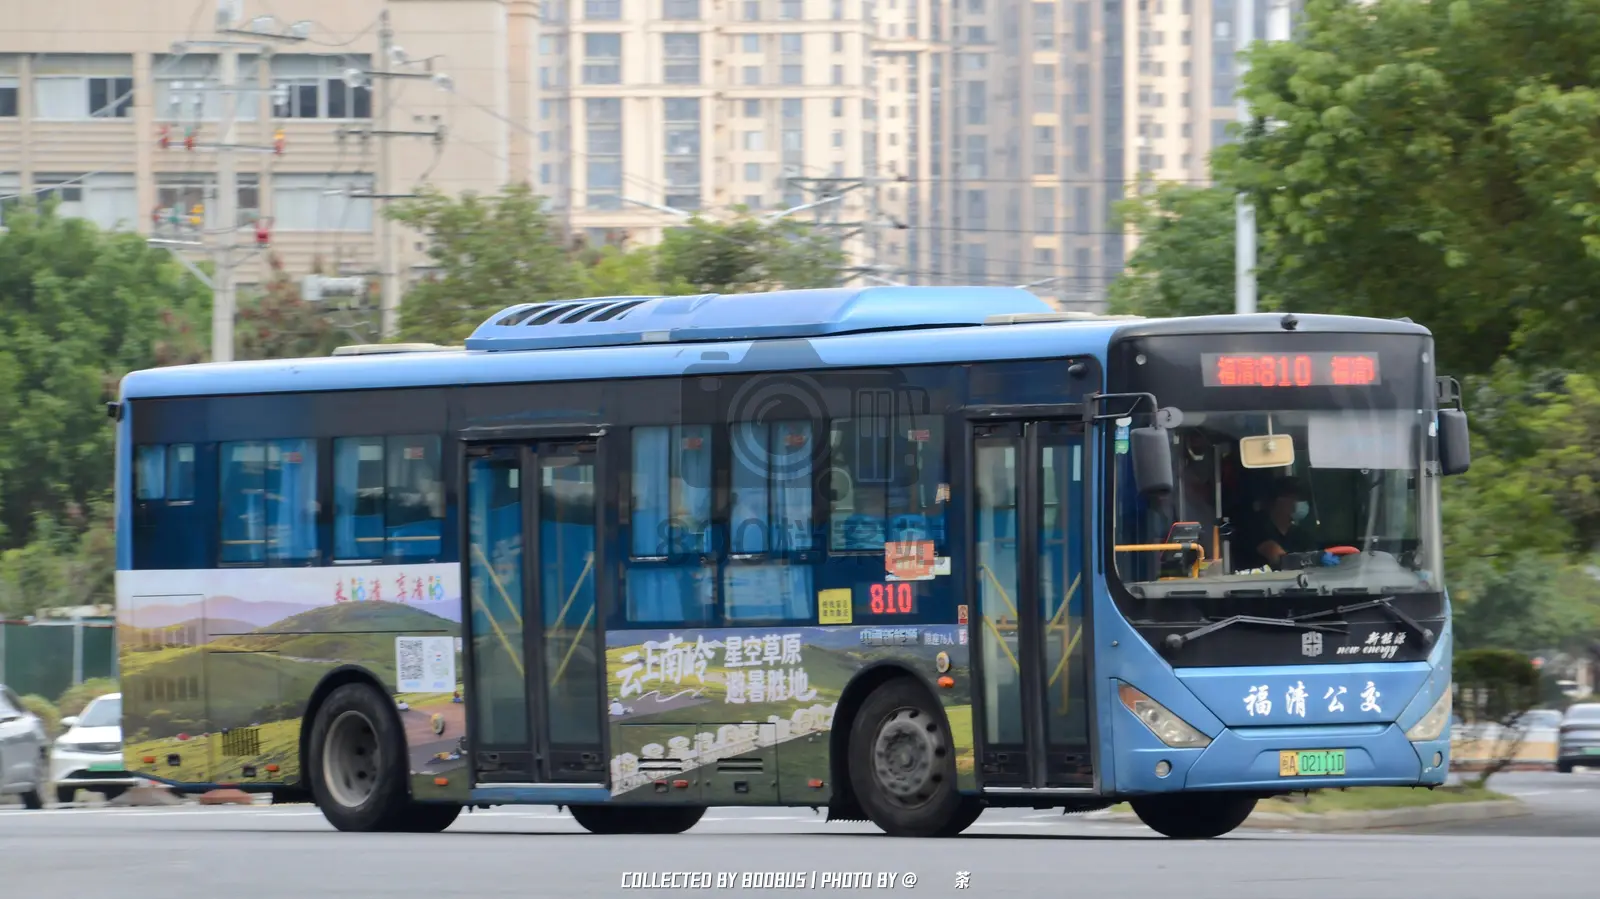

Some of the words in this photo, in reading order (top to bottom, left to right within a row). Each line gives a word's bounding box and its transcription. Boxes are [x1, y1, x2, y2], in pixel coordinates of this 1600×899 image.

[870, 583, 912, 614] 810
[723, 634, 802, 668] 星空草原
[1336, 646, 1360, 655] new
[1362, 645, 1399, 659] energy
[1365, 632, 1406, 645] 新能源
[615, 633, 716, 698] 云上南岭
[724, 668, 817, 704] 避暑胜地
[1243, 681, 1382, 717] 福清公交
